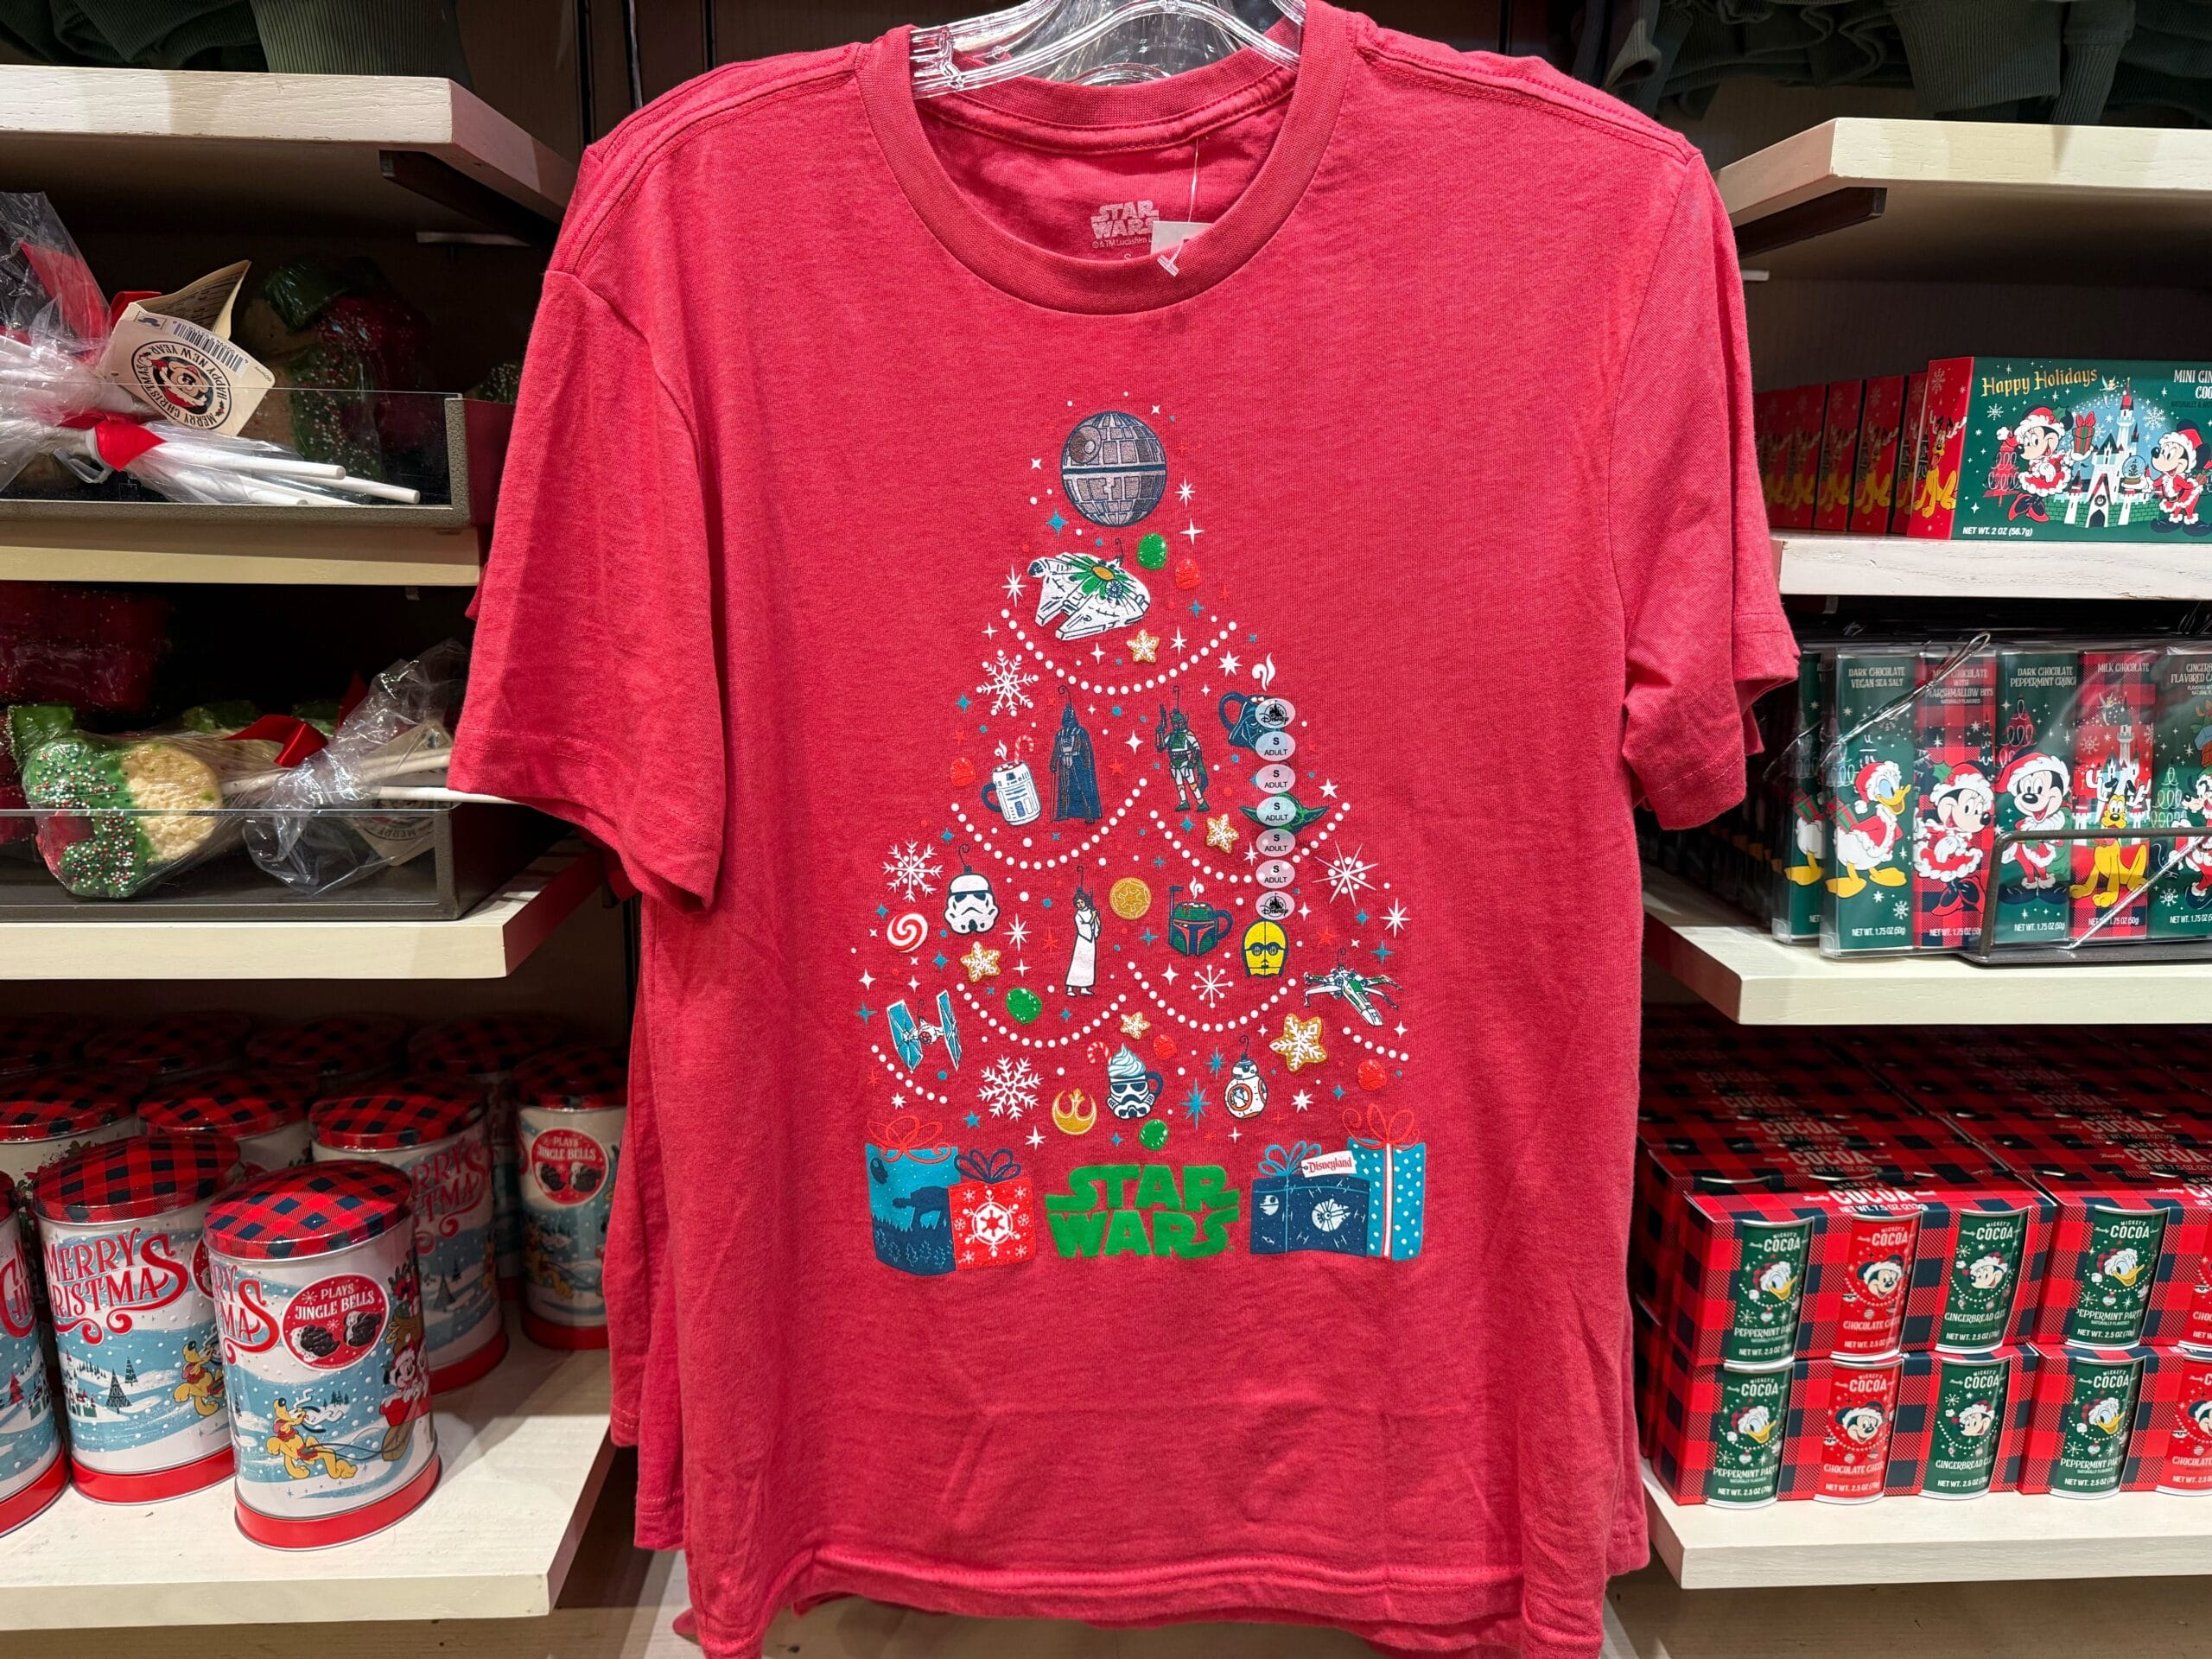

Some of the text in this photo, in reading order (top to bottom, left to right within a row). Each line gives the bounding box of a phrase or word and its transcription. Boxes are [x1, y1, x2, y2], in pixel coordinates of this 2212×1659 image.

[1090, 200, 1160, 223] STAR
[152, 345, 228, 401] HAPPY NEW YEAR
[2173, 369, 2196, 383] MINI
[1981, 367, 2097, 397] Happy Holidays
[137, 363, 217, 428] MERRY CHRISTMAS
[1998, 527, 2008, 536] OZ
[2008, 527, 2032, 537] (56.7g)
[1849, 667, 1905, 677] DARK CHOCOLATE
[2037, 666, 2073, 676] CHOCOLATE
[2098, 663, 2150, 672] MILK CHOCOLATE
[1851, 678, 1874, 688] VEGAN
[2010, 677, 2054, 688] PEPPERMINT
[2171, 674, 2205, 683] FLAVORED
[1980, 688, 1994, 696] BITS
[1259, 713, 1289, 725] Disney
[1273, 737, 1280, 746] S
[1274, 802, 1281, 810] S
[1260, 905, 1288, 917] Disney
[1852, 928, 1863, 937] NET
[2025, 923, 2036, 931] WT.
[1759, 1122, 1841, 1135] COCOA
[2081, 1121, 2164, 1133] COCOA
[553, 1136, 578, 1146] PLAYS
[537, 1147, 596, 1161] JINGLE BELLS
[1788, 1151, 1873, 1165] COCOA
[2124, 1148, 2211, 1163] COCOA
[1307, 1157, 1352, 1173] Disneyland
[1046, 1164, 1241, 1211] STAR
[1828, 1187, 1917, 1205] COCOA
[1047, 1207, 1240, 1258] WARS
[1872, 1230, 1908, 1246] COCOA
[1976, 1226, 2013, 1241] COCOA
[2110, 1225, 2150, 1239] COCOA
[1764, 1236, 1801, 1253] COCOA
[44, 1227, 142, 1283] MERRY
[321, 1282, 354, 1300] PLAYS
[295, 1290, 375, 1321] JINGLE BELLS
[1944, 1312, 1994, 1324] GINGERBREAD
[1842, 1320, 1885, 1331] CHOCOLATE
[1733, 1326, 1780, 1338] PEPPERMINT
[2193, 1331, 2207, 1339] NET
[1849, 1378, 1887, 1393] COCOA
[1964, 1374, 1999, 1389] COCOA
[2093, 1374, 2129, 1388] COCOA
[1741, 1382, 1778, 1396] COCOA
[1823, 1464, 1866, 1474] CHOCOLATE
[1936, 1459, 1982, 1471] GINGERBREAD
[2060, 1458, 2107, 1469] PEPPERMINT
[1713, 1467, 1760, 1479] PEPPERMINT
